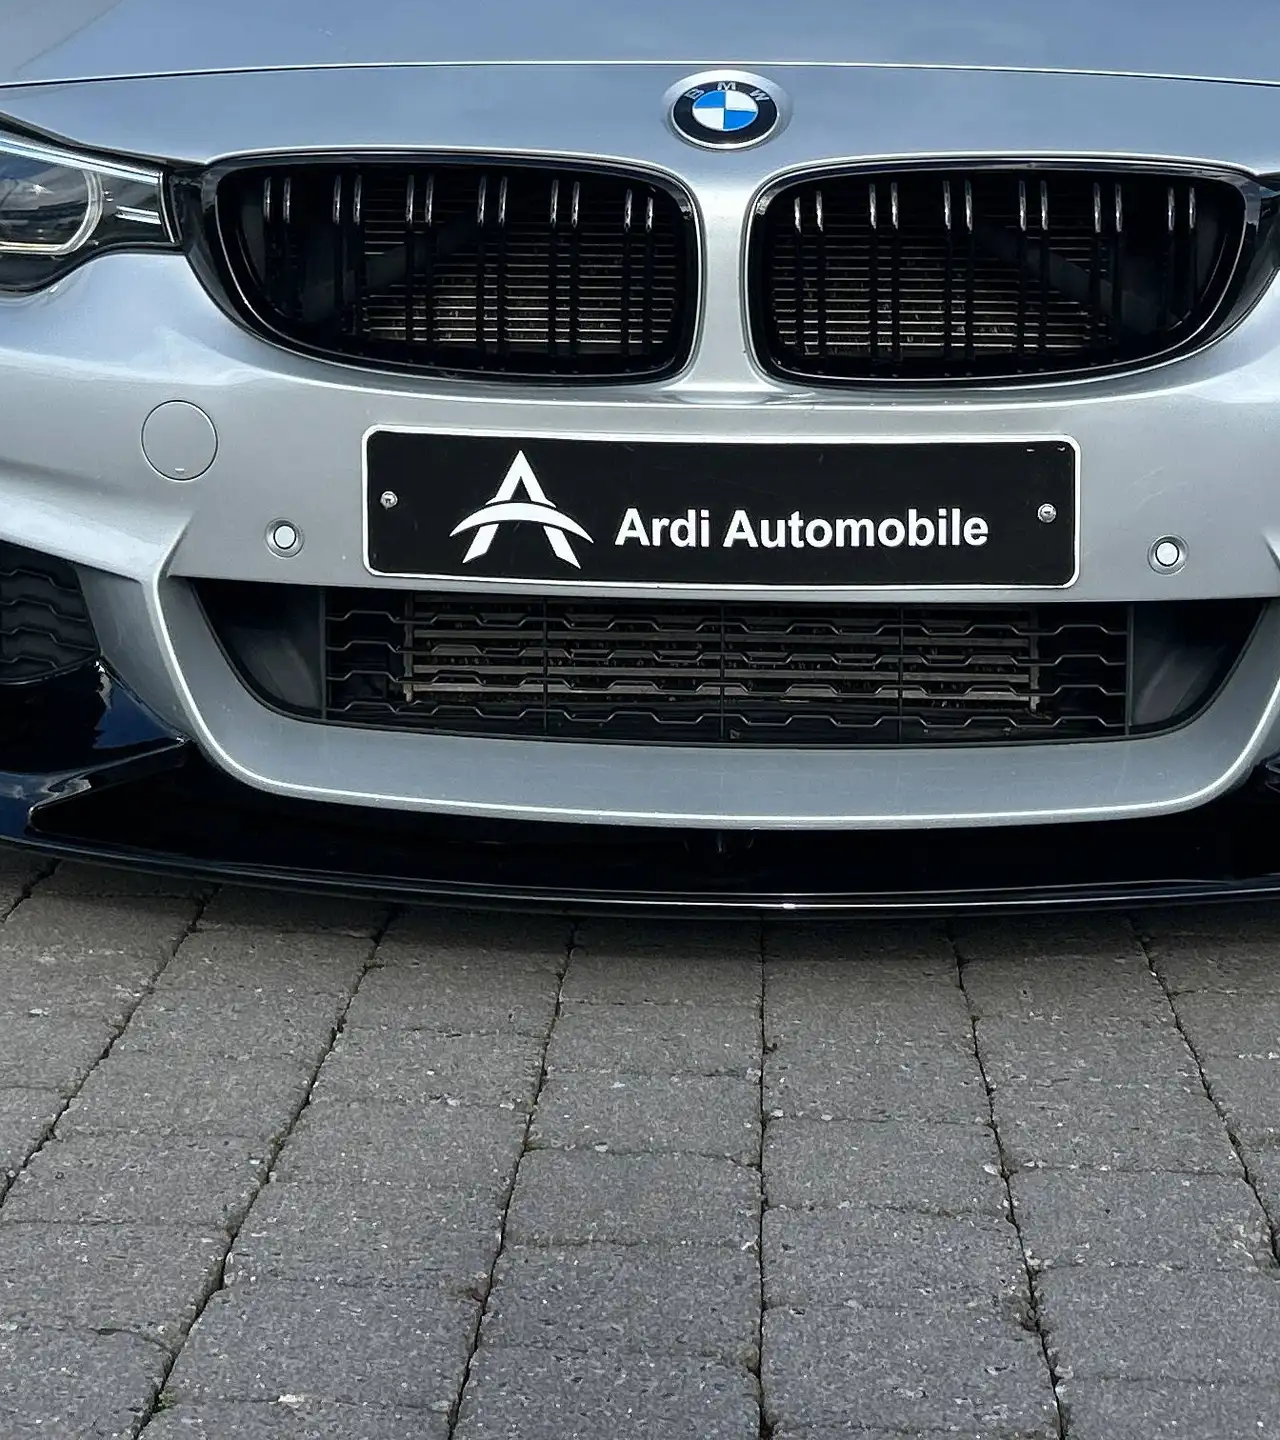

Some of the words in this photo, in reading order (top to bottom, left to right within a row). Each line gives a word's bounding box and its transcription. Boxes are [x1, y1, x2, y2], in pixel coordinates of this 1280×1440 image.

[683, 81, 770, 101] BMW
[614, 507, 711, 547] Ardi
[722, 508, 989, 547] Automobile
